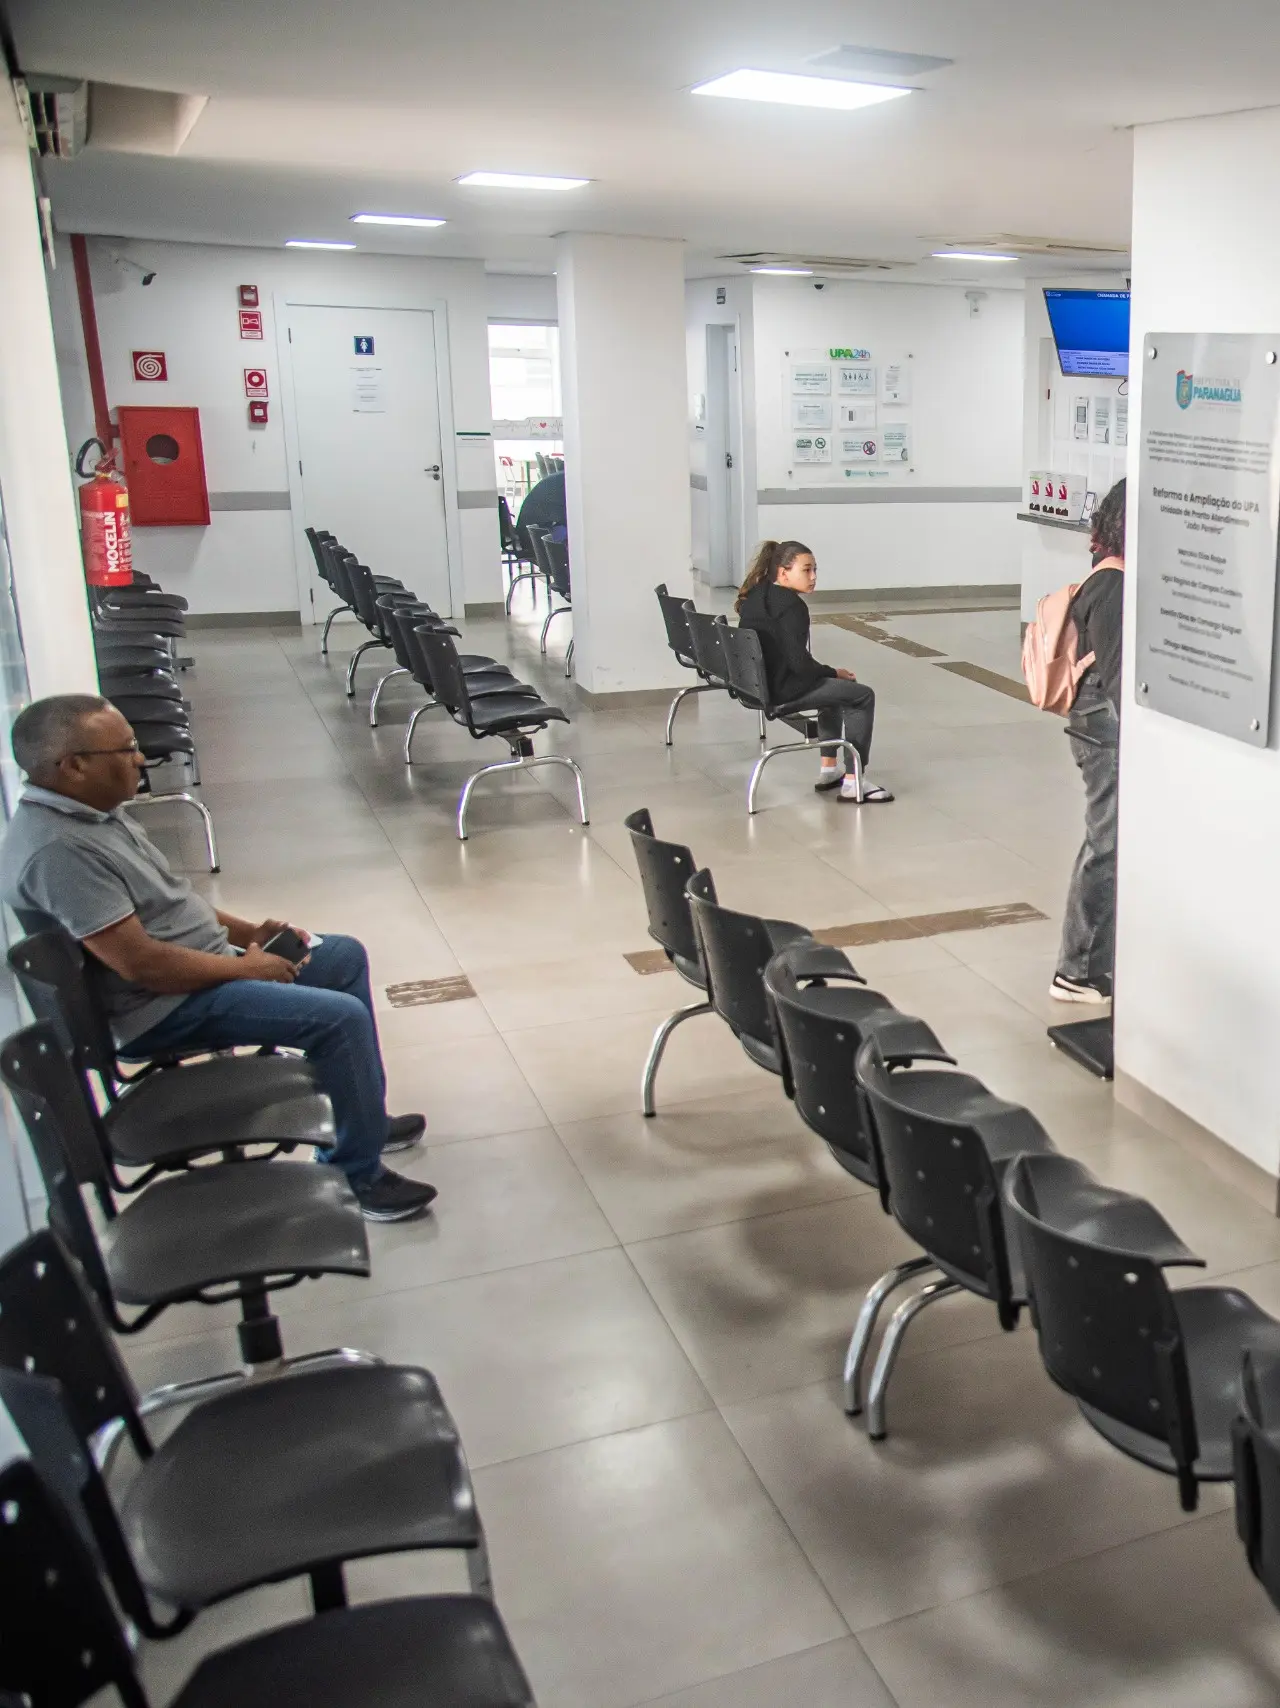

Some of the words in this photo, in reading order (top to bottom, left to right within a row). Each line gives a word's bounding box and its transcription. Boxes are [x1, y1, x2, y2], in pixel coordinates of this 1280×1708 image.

[1153, 487, 1182, 500] Reforma
[1184, 494, 1189, 502] e
[1190, 493, 1230, 511] Ampliação
[1244, 501, 1259, 513] UPA
[104, 511, 119, 572] MOCELIN
